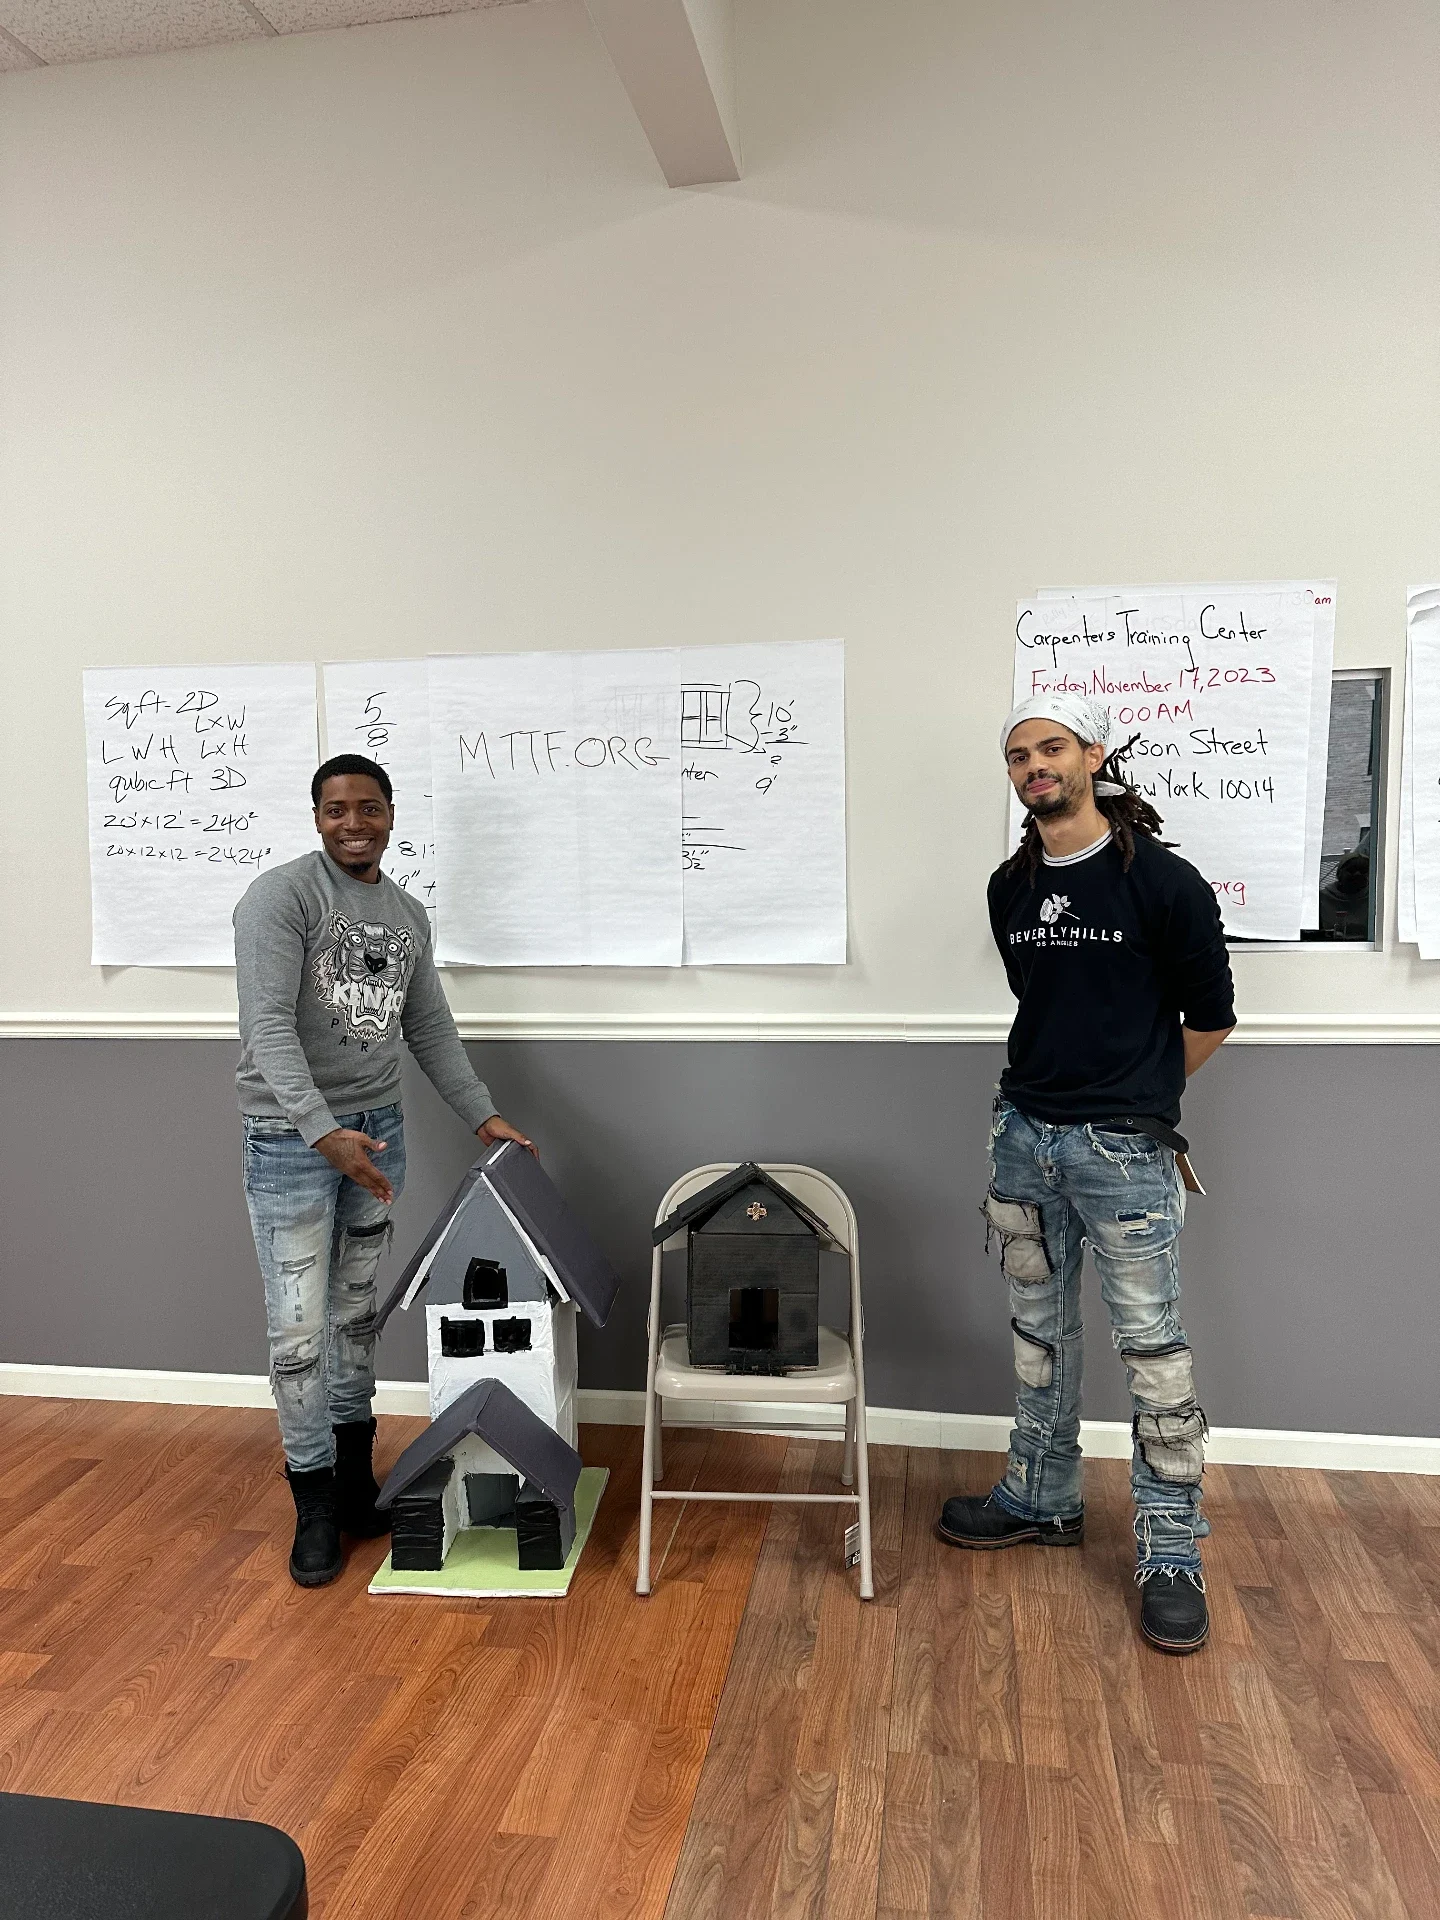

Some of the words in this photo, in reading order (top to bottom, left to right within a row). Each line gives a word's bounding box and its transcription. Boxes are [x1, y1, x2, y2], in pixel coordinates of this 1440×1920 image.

[1016, 610, 1116, 668] Carpenters
[1116, 609, 1195, 672] Training
[1200, 604, 1267, 642] Center
[1190, 728, 1269, 756] Street
[210, 766, 247, 790] 3D
[1158, 769, 1209, 799] York
[1220, 776, 1275, 803] 10014
